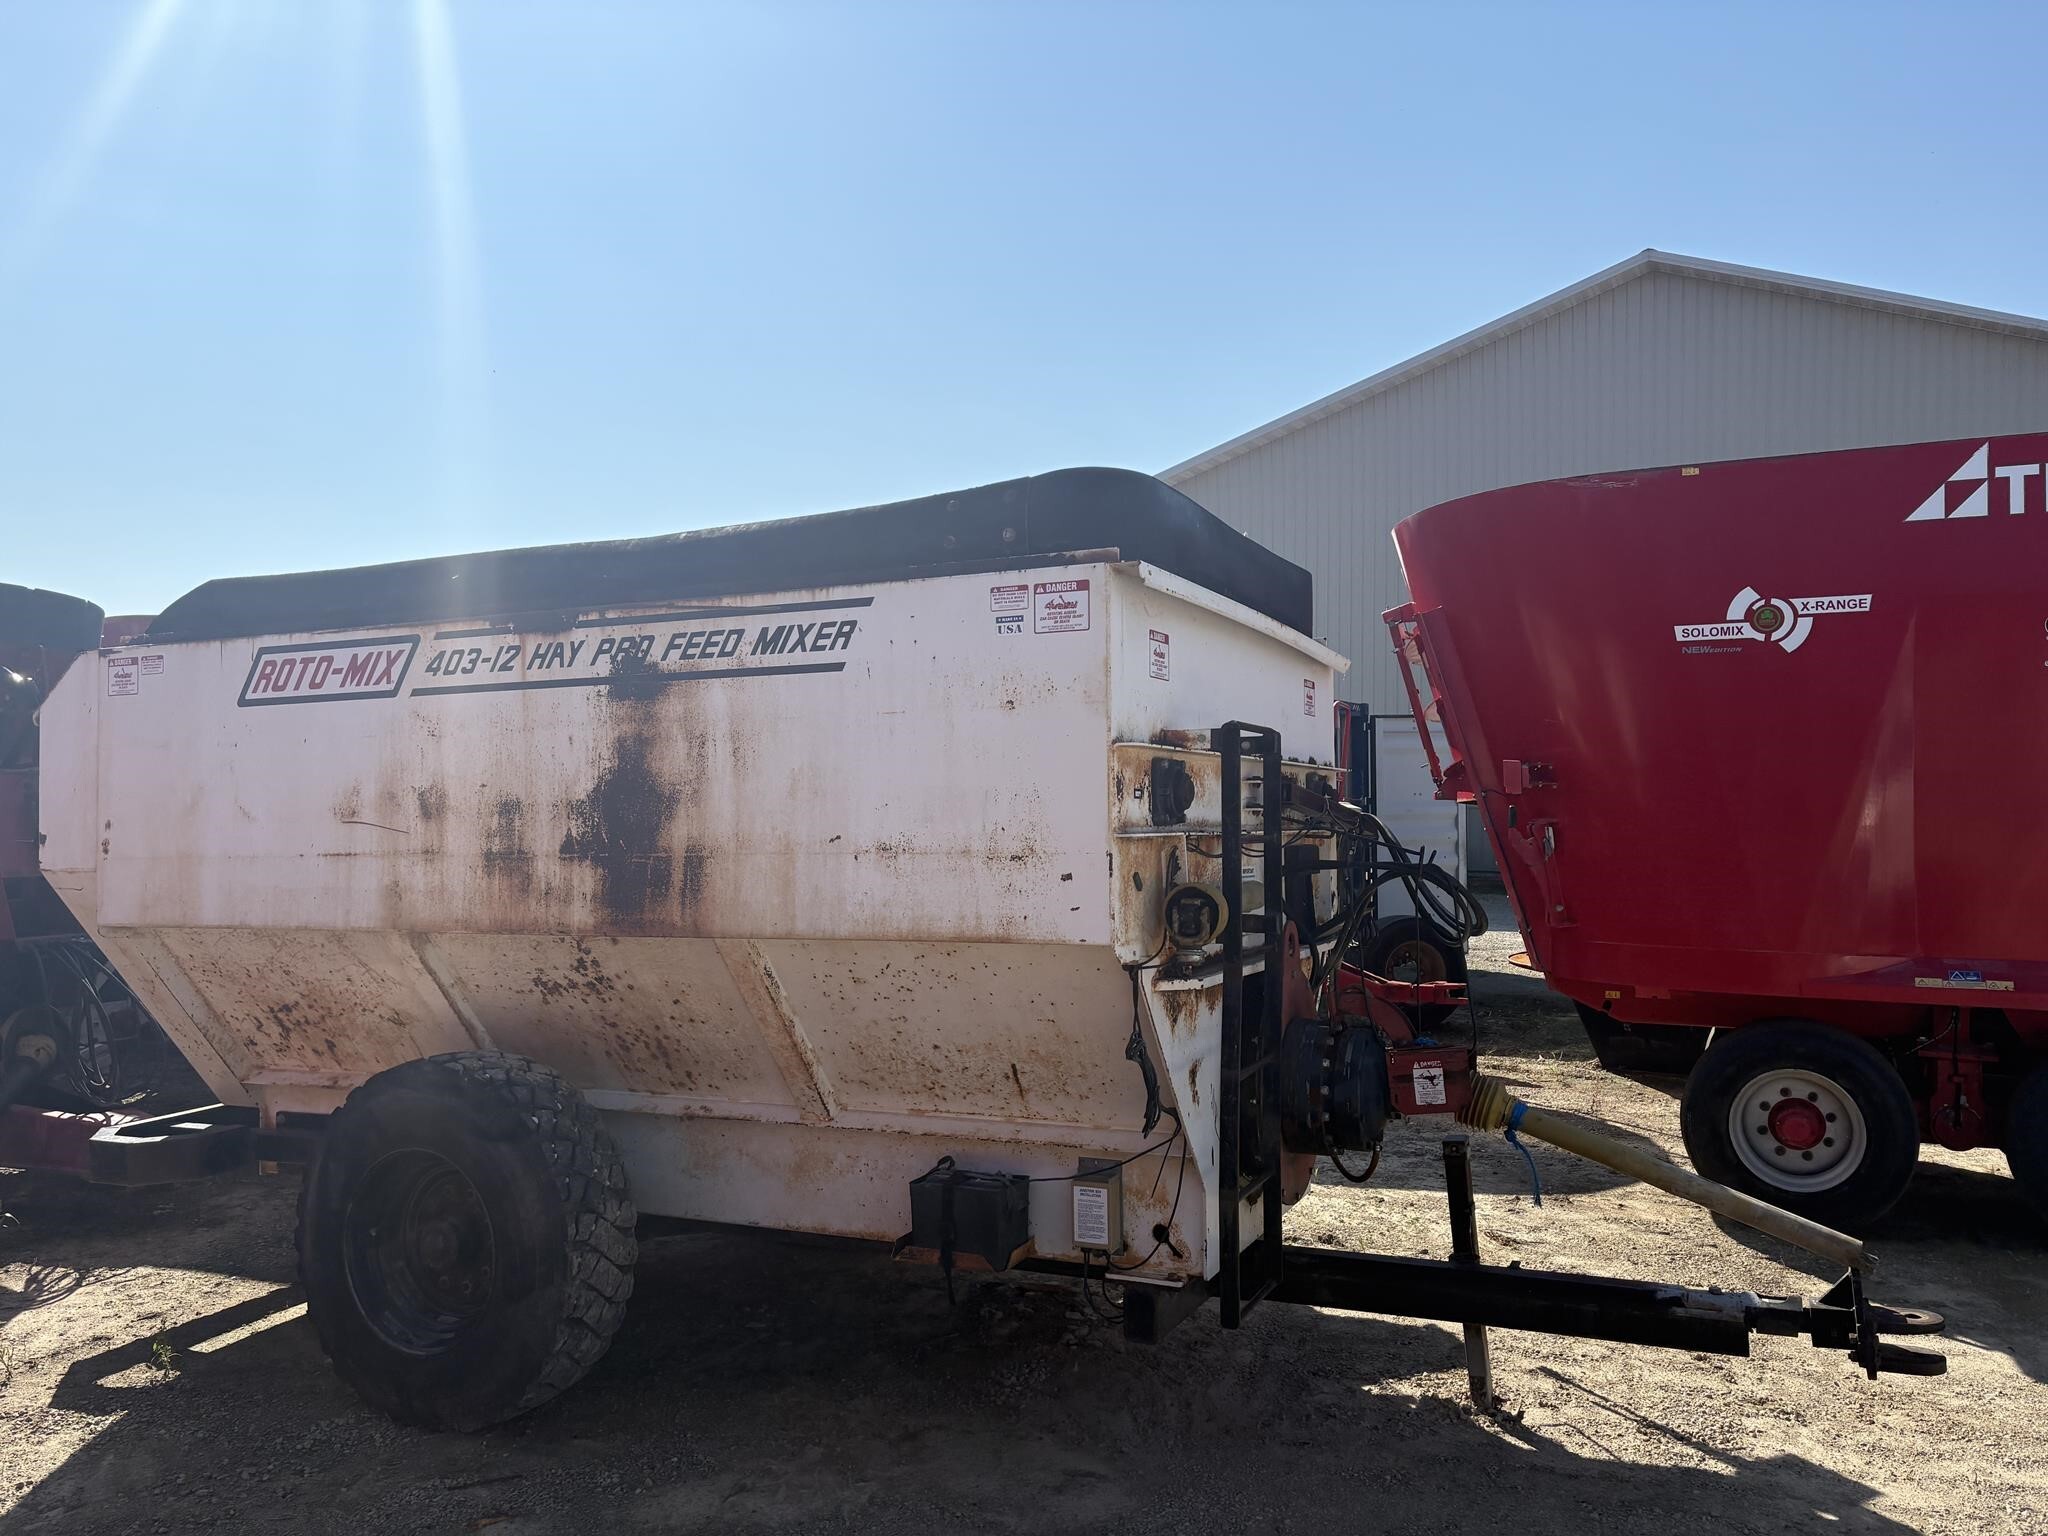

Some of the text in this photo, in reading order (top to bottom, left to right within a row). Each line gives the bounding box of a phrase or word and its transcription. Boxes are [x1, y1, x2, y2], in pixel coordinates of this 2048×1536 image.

[1995, 463, 2048, 515] T
[1046, 582, 1078, 592] DANGER
[1800, 598, 1868, 612] X-RANGE
[998, 624, 1022, 634] USA
[1681, 625, 1744, 638] SOLOMIX
[425, 645, 521, 676] 403-12
[526, 640, 585, 670] HAY
[660, 628, 745, 661] FEED
[750, 619, 857, 656] MIXER
[251, 649, 405, 694] ROTO-MIX
